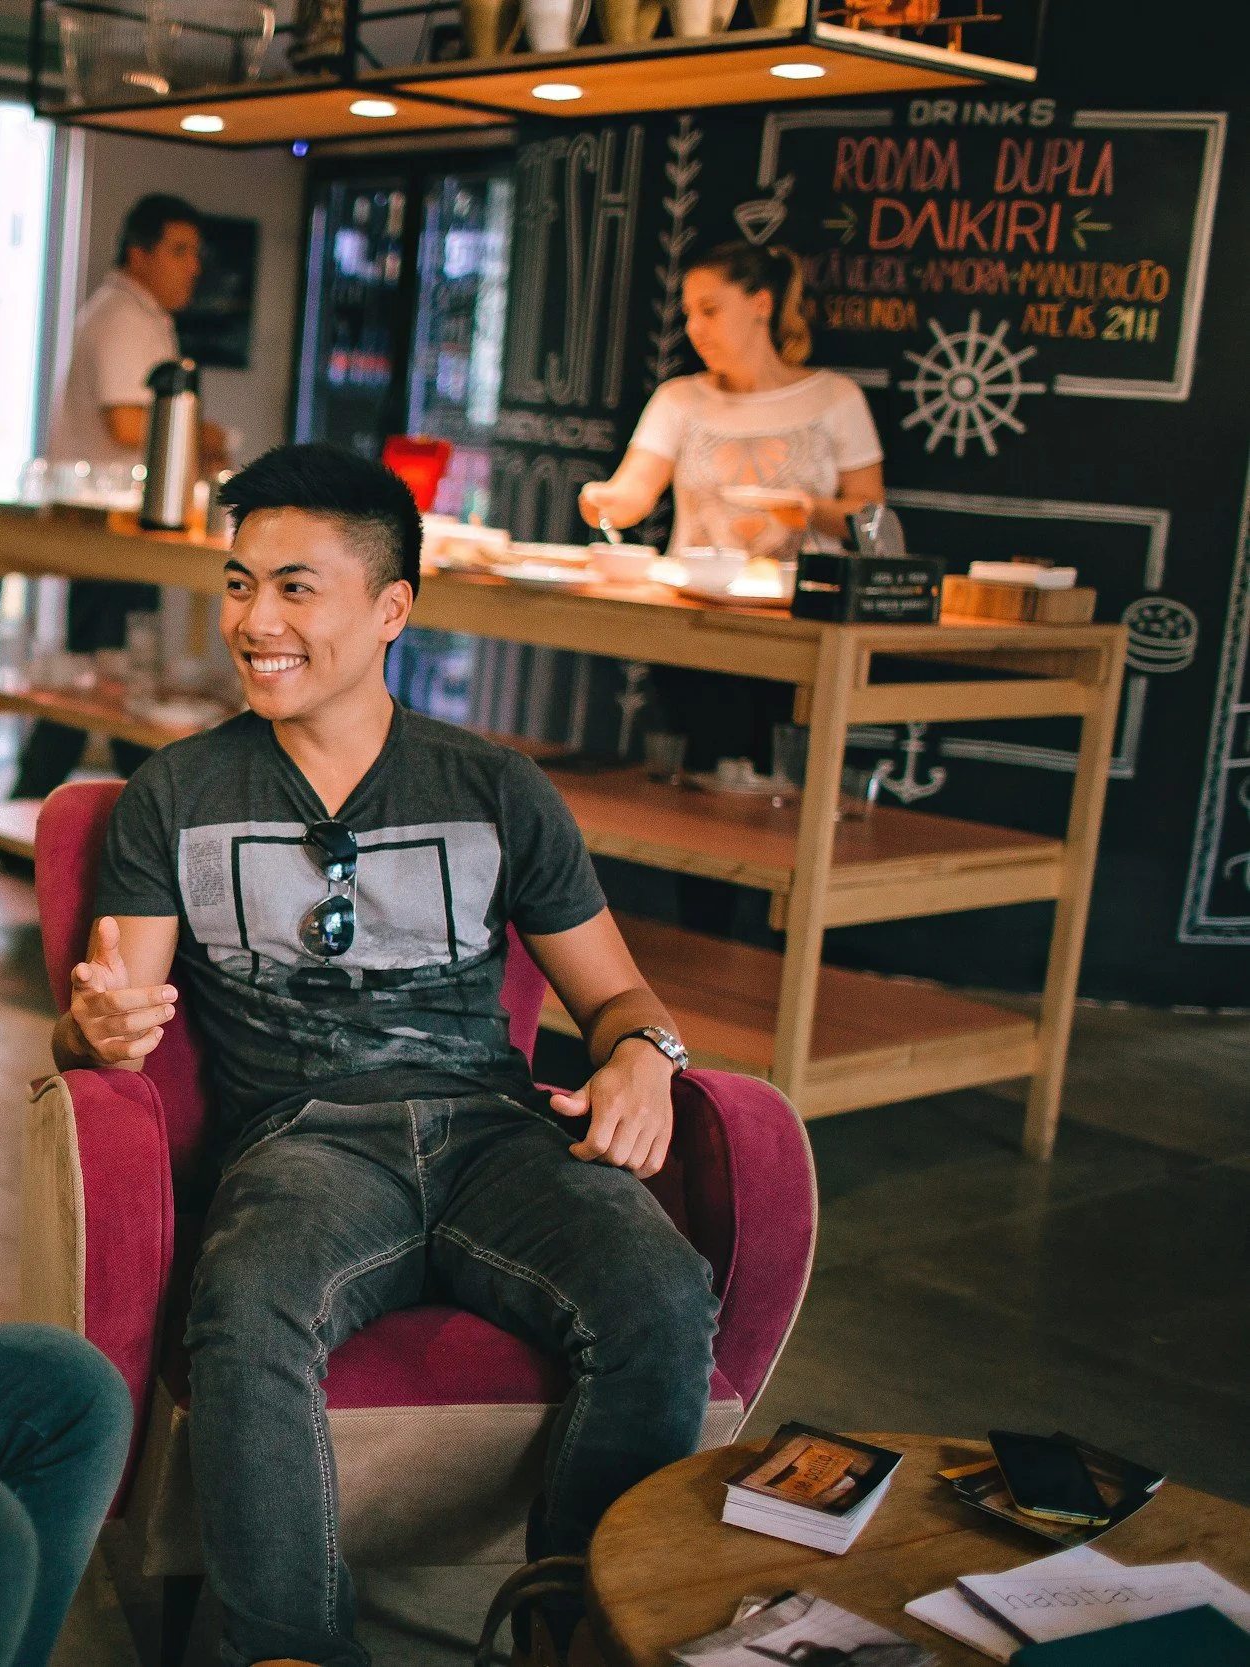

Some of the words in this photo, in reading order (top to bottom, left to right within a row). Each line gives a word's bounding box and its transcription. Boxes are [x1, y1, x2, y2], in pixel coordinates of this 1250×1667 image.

[908, 98, 1057, 128] DRINKS
[832, 136, 961, 193] RODADA
[994, 137, 1114, 197] DUPLA
[867, 198, 1063, 254] DAIKIRI
[920, 256, 1012, 295] AMORA
[1100, 304, 1161, 343] 21H
[991, 1583, 1154, 1611] habitat
